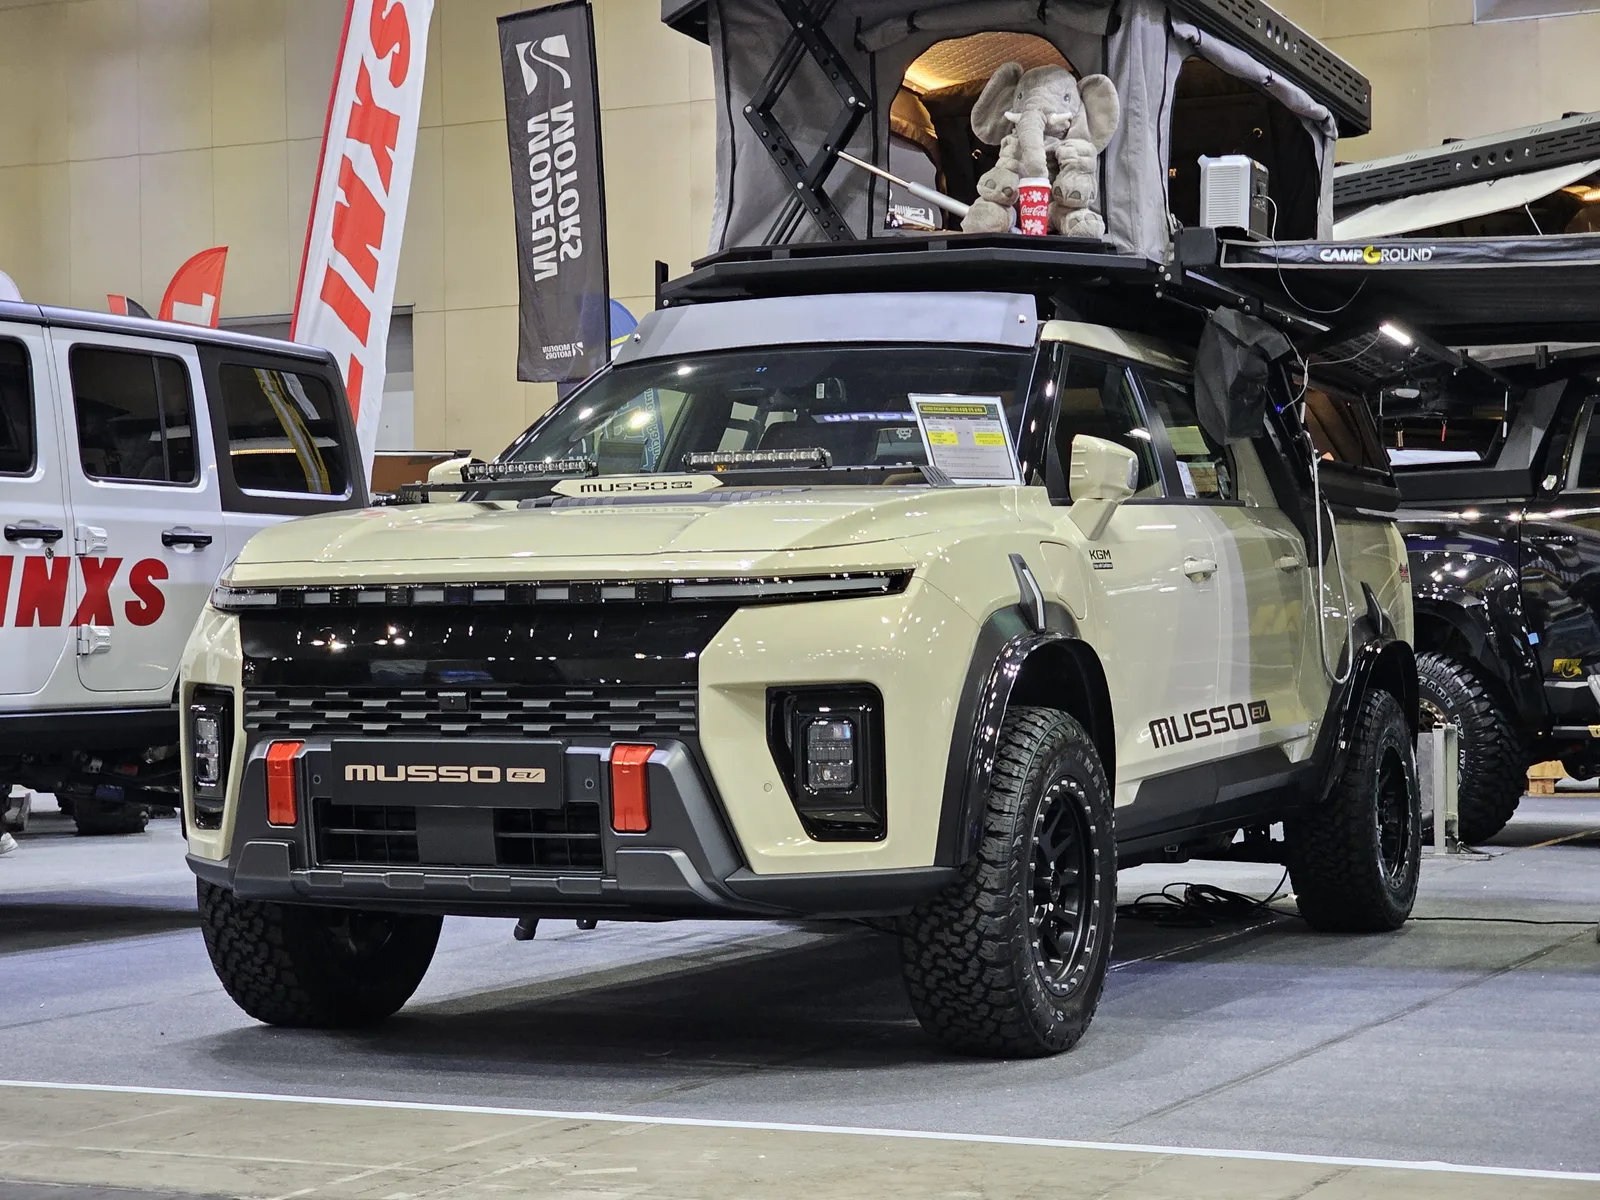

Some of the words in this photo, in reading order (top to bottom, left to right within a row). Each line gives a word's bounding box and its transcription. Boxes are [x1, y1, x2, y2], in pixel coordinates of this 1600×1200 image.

[320, 0, 411, 427] INXS
[580, 481, 667, 493] MUSSO
[1089, 550, 1111, 560] KGM
[1148, 702, 1248, 748] MUSSO
[1251, 705, 1267, 719] EV
[345, 764, 501, 783] MUSSO
